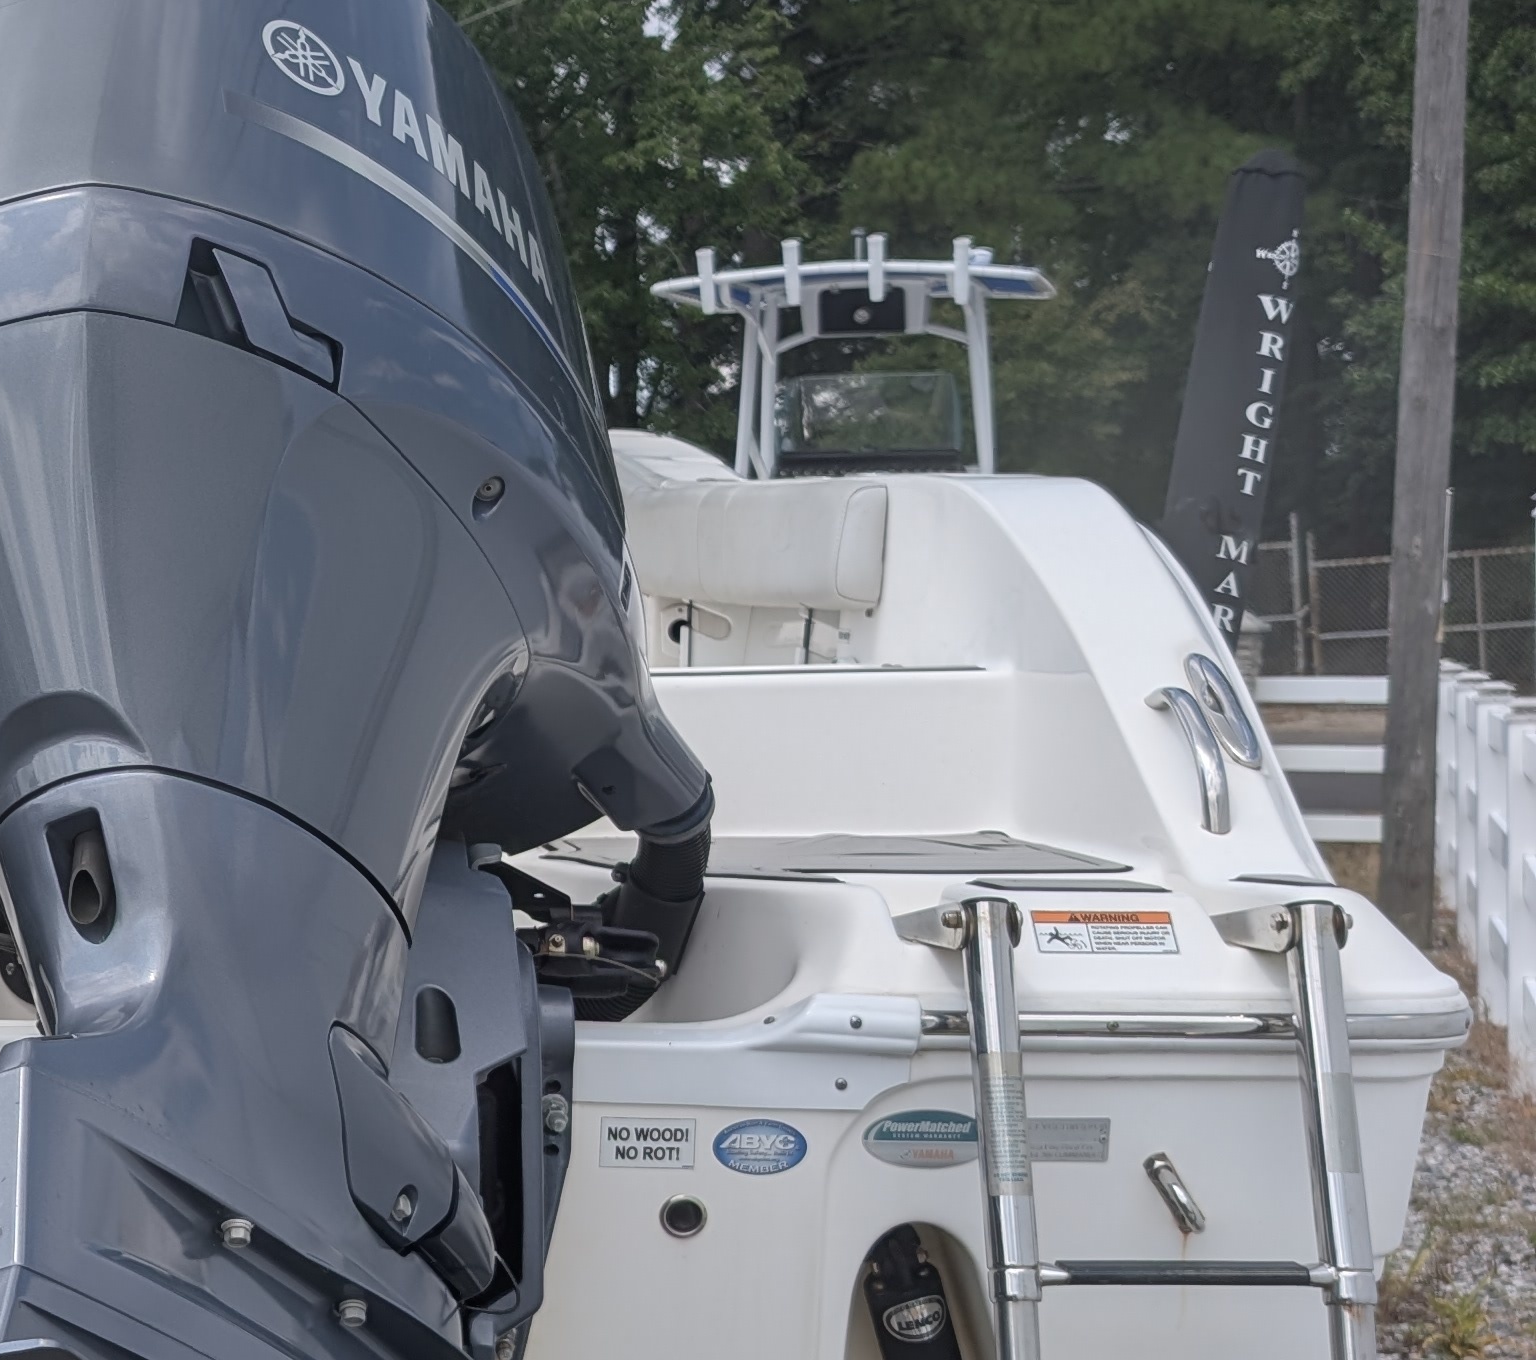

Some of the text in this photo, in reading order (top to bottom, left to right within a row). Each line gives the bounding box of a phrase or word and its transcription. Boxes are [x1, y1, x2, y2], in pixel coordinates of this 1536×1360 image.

[346, 55, 553, 304] YAMAHA
[1238, 293, 1294, 497] WRIGHT
[1080, 913, 1140, 923] WARNING
[607, 1126, 689, 1143] NO WOOD!
[882, 1120, 972, 1133] PowerMatched
[719, 1133, 795, 1151] ABYC
[615, 1145, 680, 1161] NO ROT!
[912, 1149, 954, 1159] YAMAHA
[728, 1159, 789, 1173] MEMBER
[897, 1310, 941, 1330] LENCO
